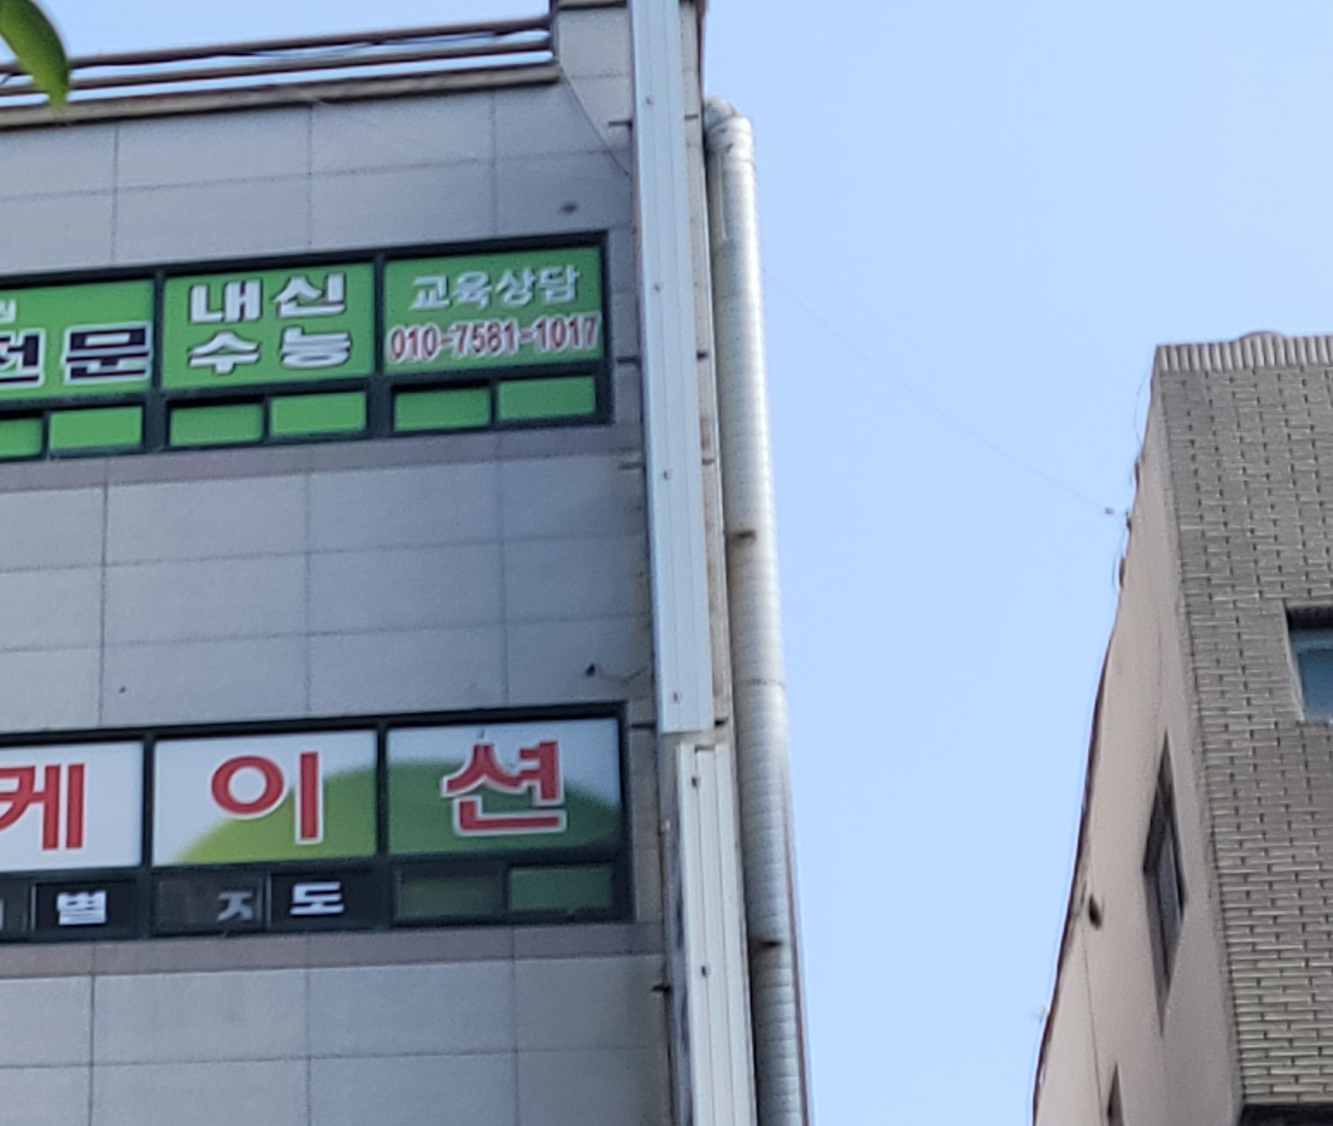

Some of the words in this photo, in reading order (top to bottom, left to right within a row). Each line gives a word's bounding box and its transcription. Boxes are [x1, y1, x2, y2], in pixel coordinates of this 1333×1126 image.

[188, 272, 348, 325] 내신
[409, 264, 580, 312] 교육상담
[187, 326, 352, 375] 수능
[388, 313, 600, 366] 010-7581-1017
